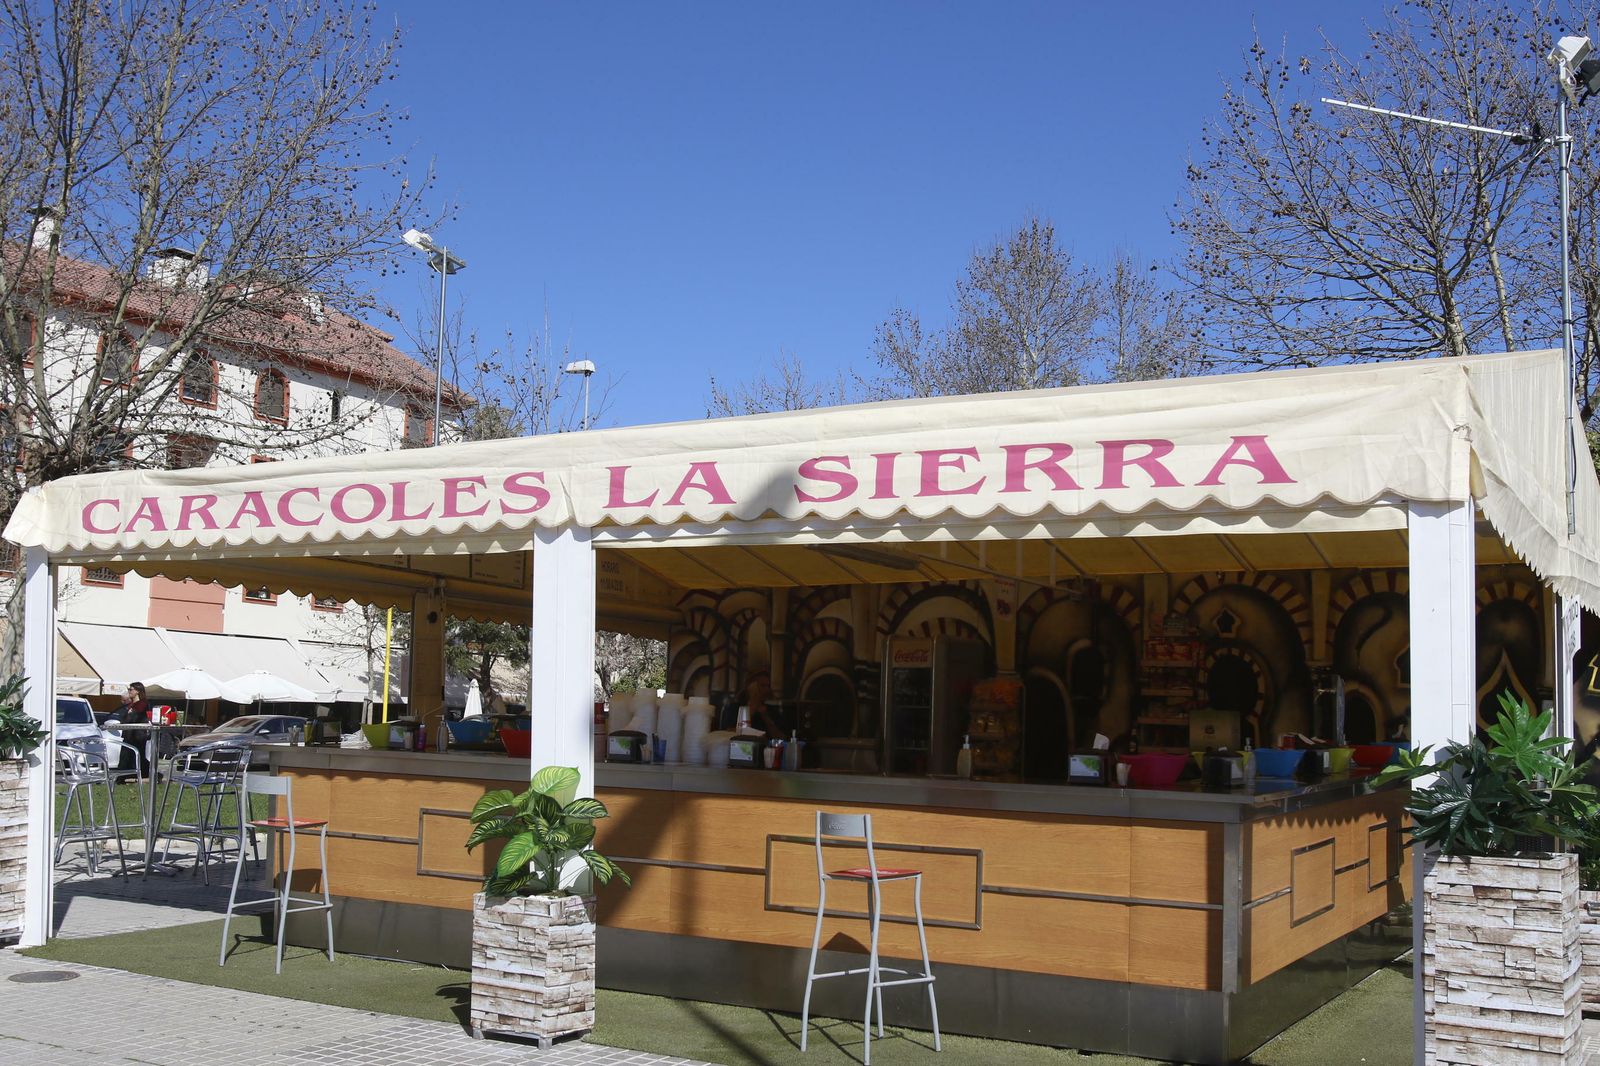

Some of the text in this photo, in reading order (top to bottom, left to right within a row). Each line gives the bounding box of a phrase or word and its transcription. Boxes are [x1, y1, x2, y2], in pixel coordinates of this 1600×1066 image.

[82, 435, 1297, 534] CARACOLES LA SIERRA
